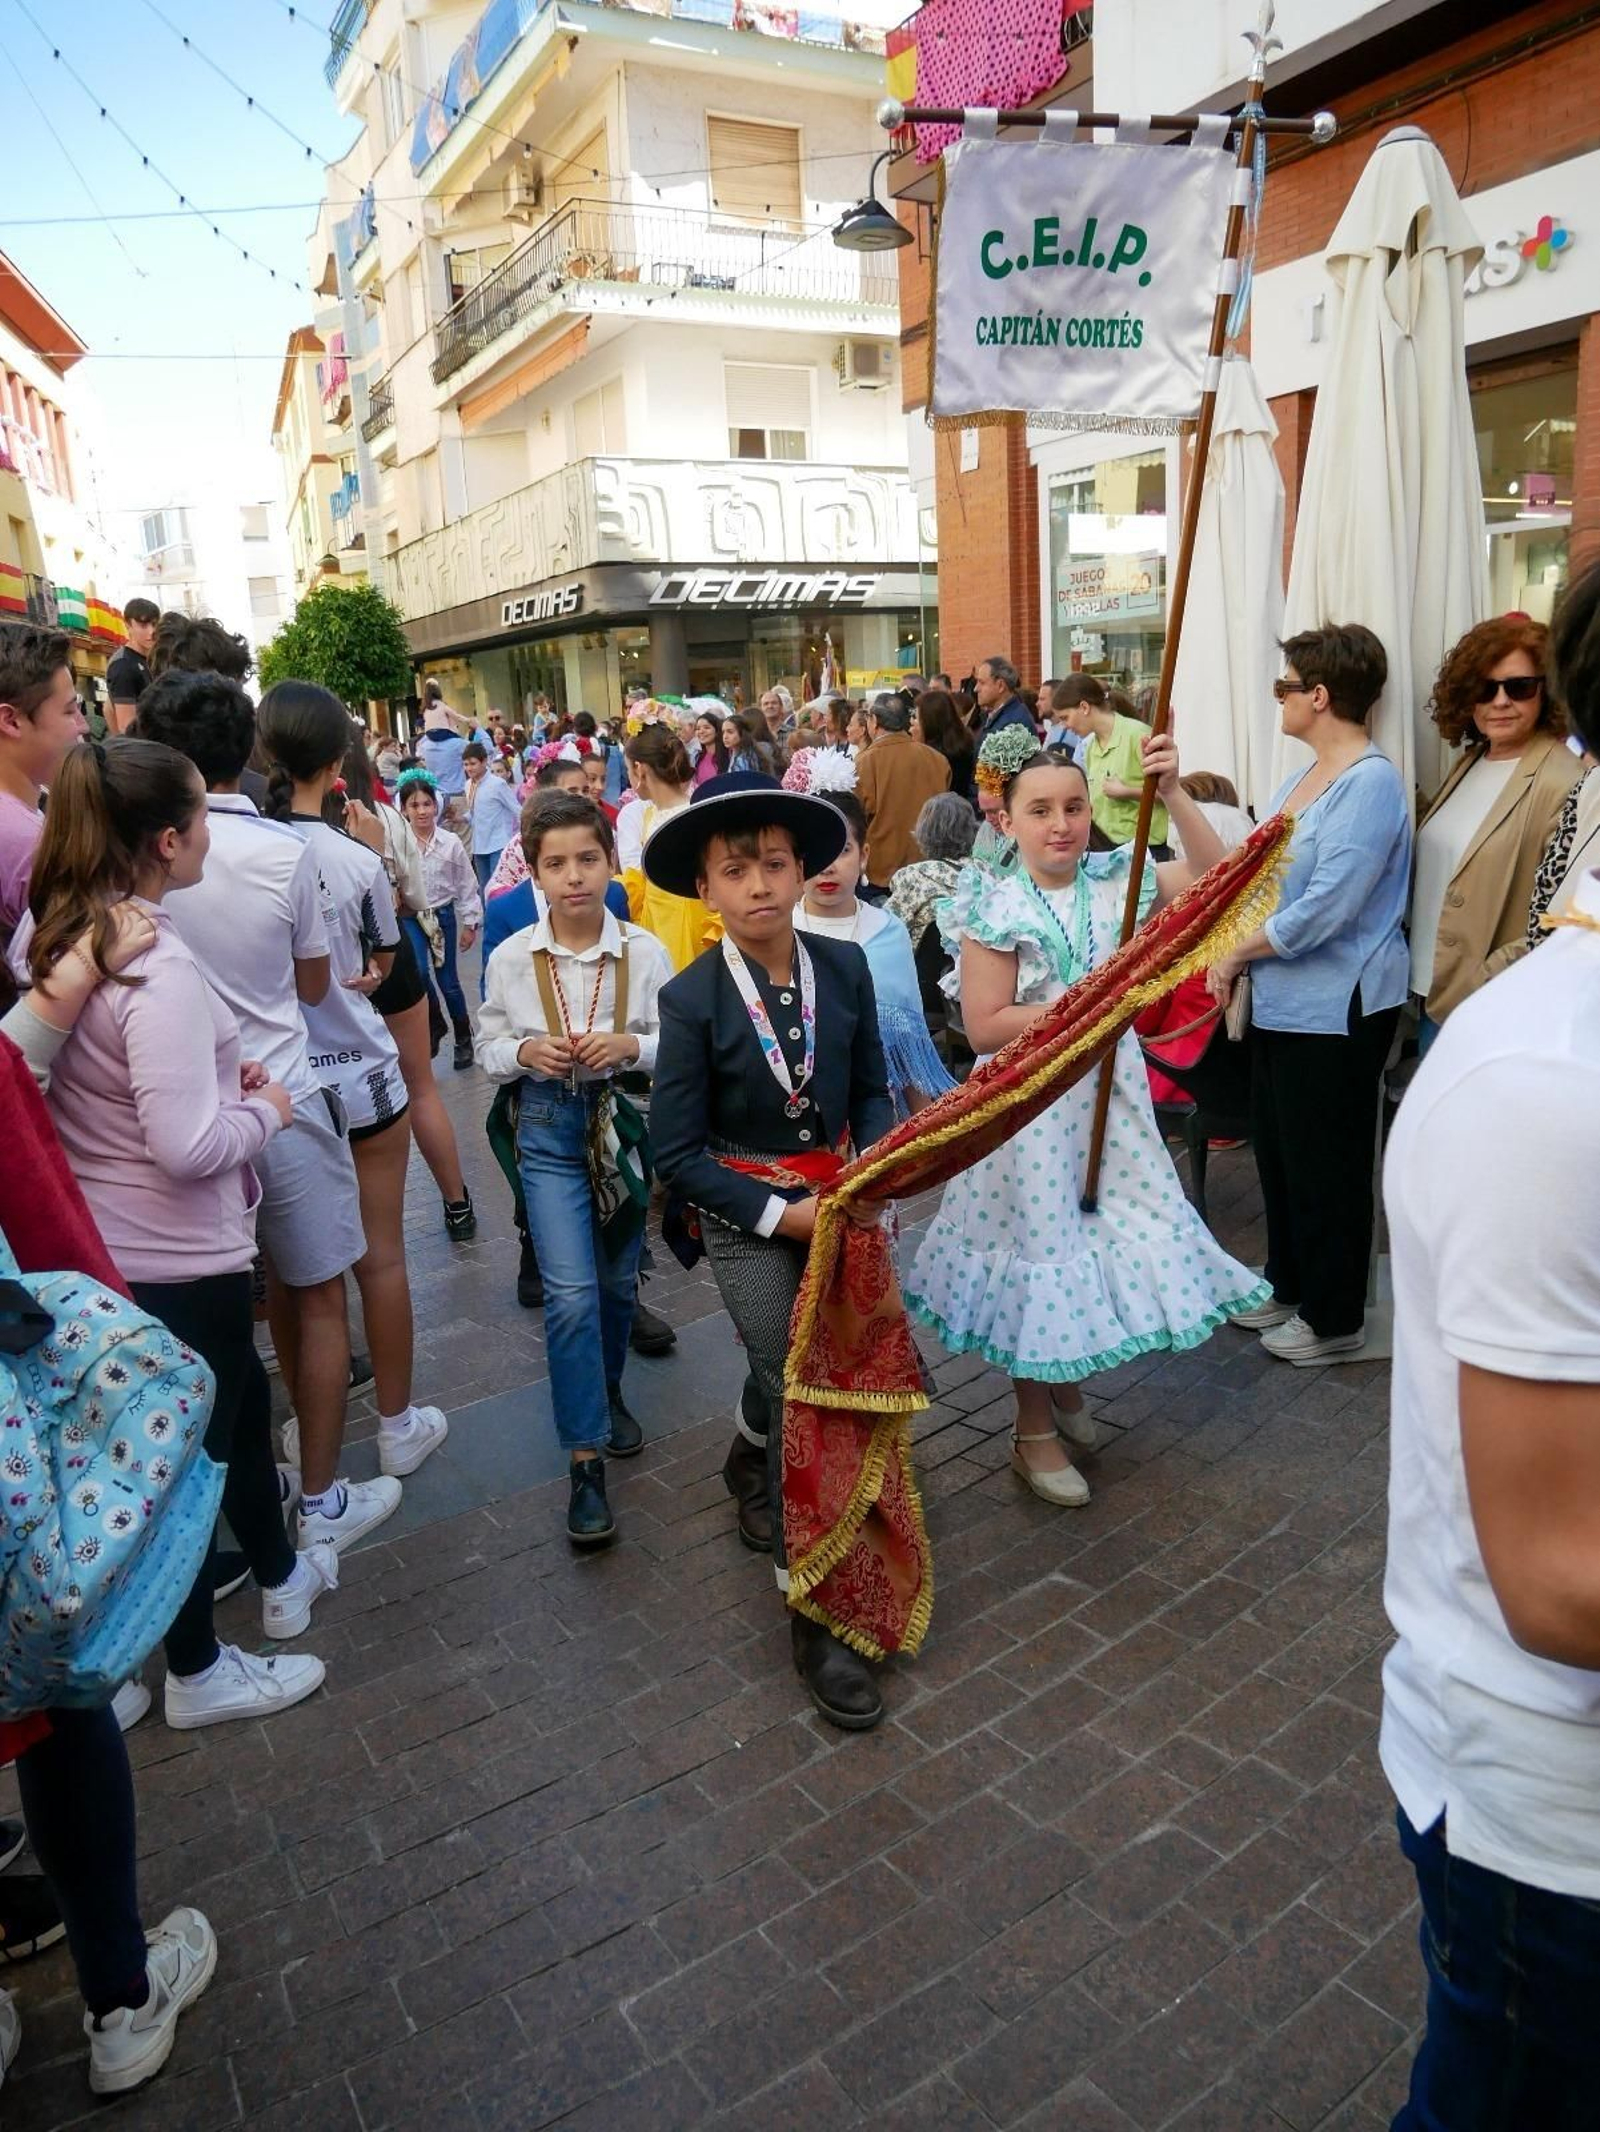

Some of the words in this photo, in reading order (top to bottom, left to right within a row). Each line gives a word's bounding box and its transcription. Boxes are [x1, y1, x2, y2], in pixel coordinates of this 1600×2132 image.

[980, 216, 1152, 288] C.E.I.P.
[976, 309, 1062, 346] CAPITÁN
[1065, 311, 1144, 349] CORTÉS
[501, 582, 579, 626] DECIMAS
[648, 572, 878, 606] DECIMAS
